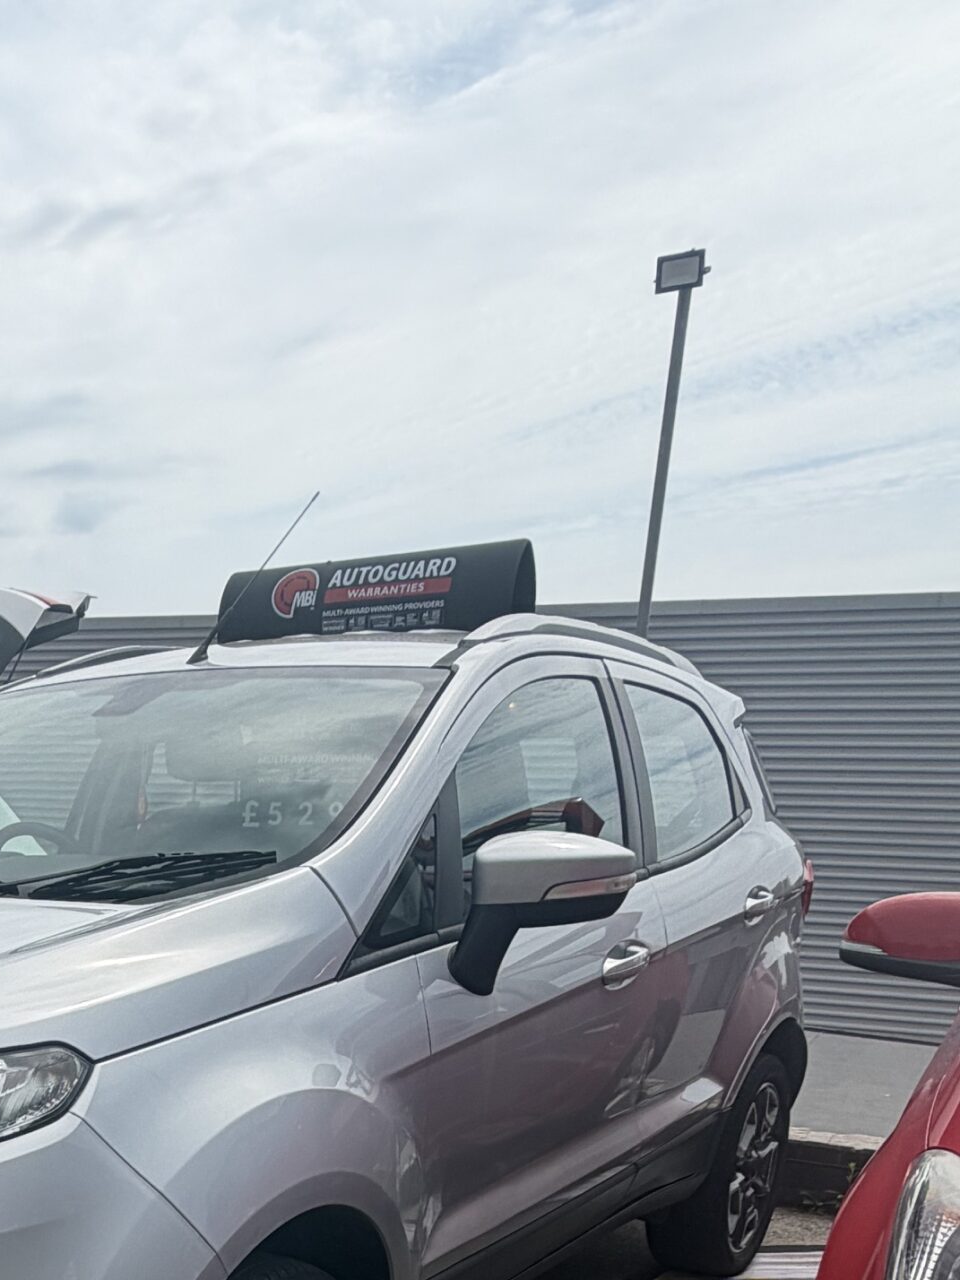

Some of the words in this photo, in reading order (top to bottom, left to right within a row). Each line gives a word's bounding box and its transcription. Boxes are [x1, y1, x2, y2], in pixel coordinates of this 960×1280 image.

[328, 557, 457, 588] AUTOGUARD
[347, 582, 425, 599] WARRANTIES
[403, 600, 445, 610] PROVIDERS
